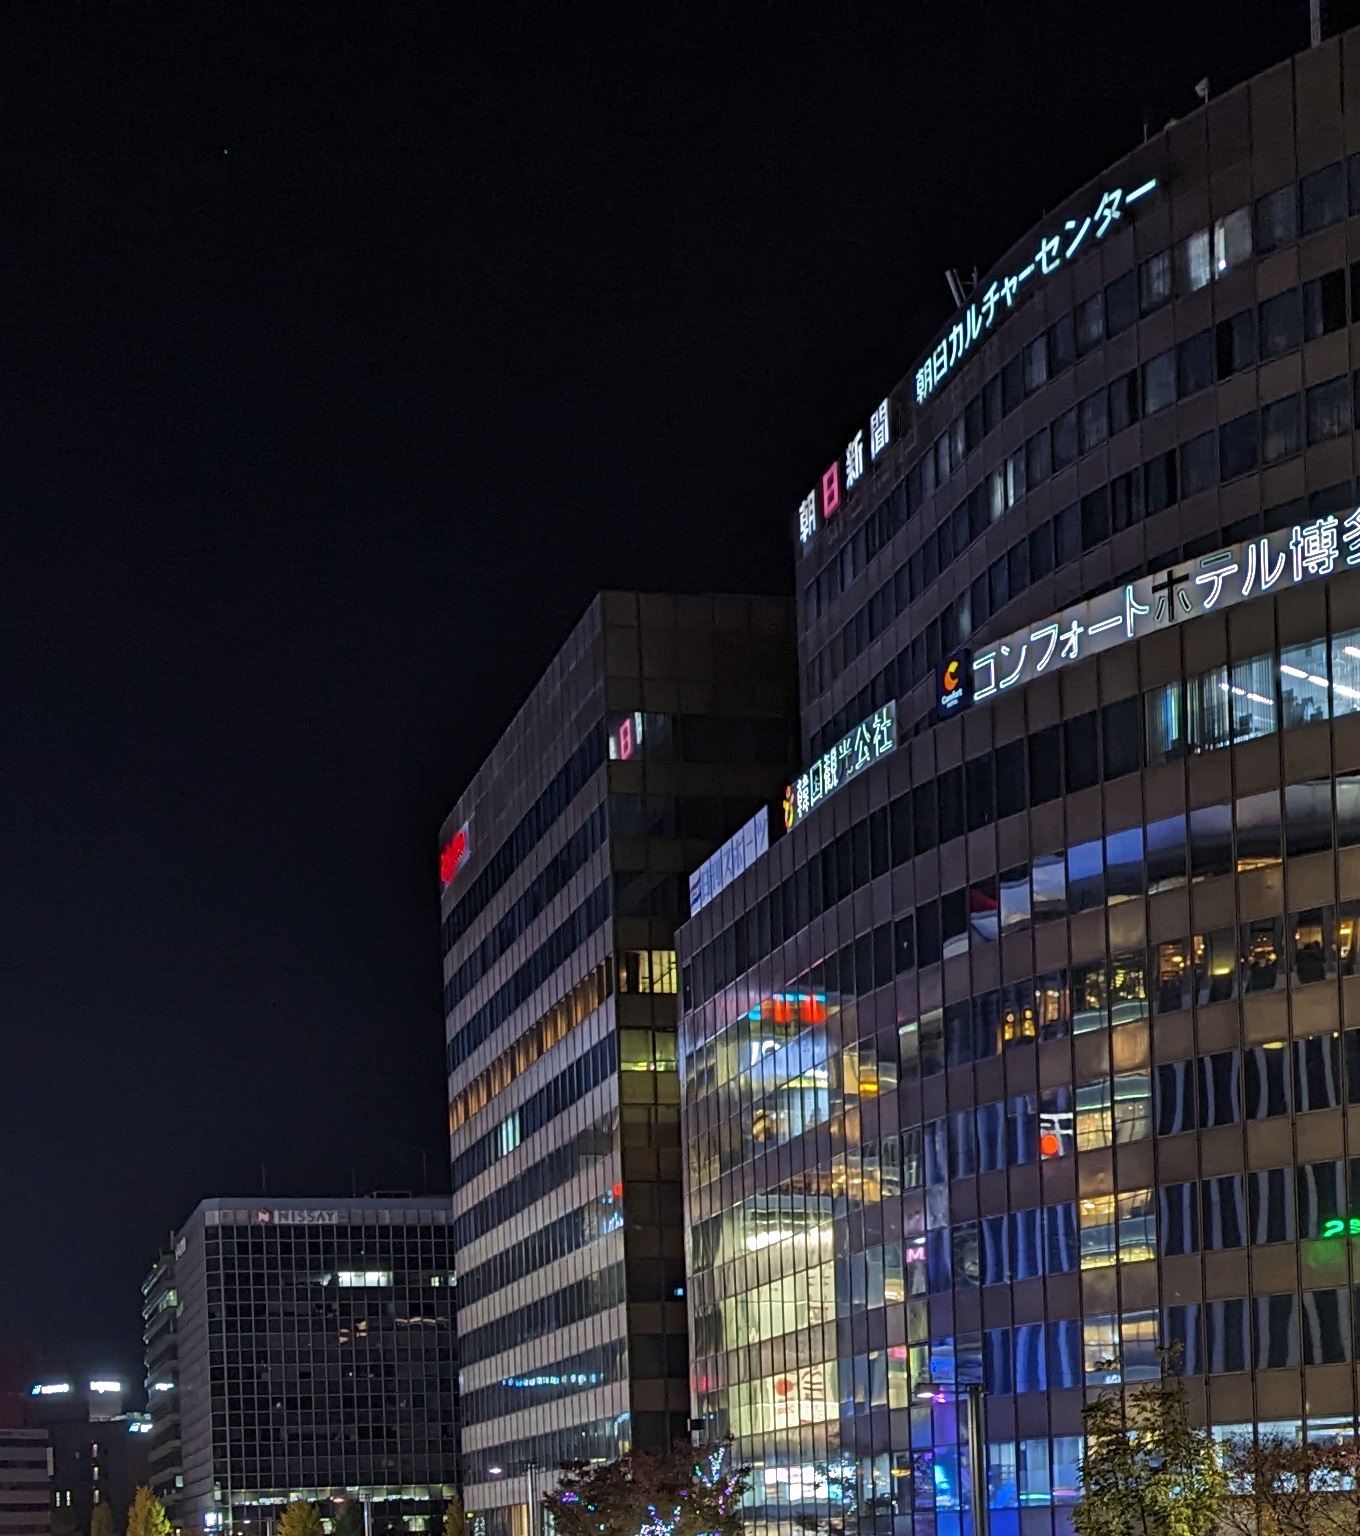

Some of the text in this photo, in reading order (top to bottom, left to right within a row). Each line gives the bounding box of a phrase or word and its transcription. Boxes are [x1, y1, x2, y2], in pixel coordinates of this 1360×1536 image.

[915, 177, 1158, 404] 朝日カルチャーセンター
[798, 397, 890, 543] 朝日新聞
[797, 706, 893, 819] 韓国観光公社
[700, 816, 769, 898] 日刊スポーツ
